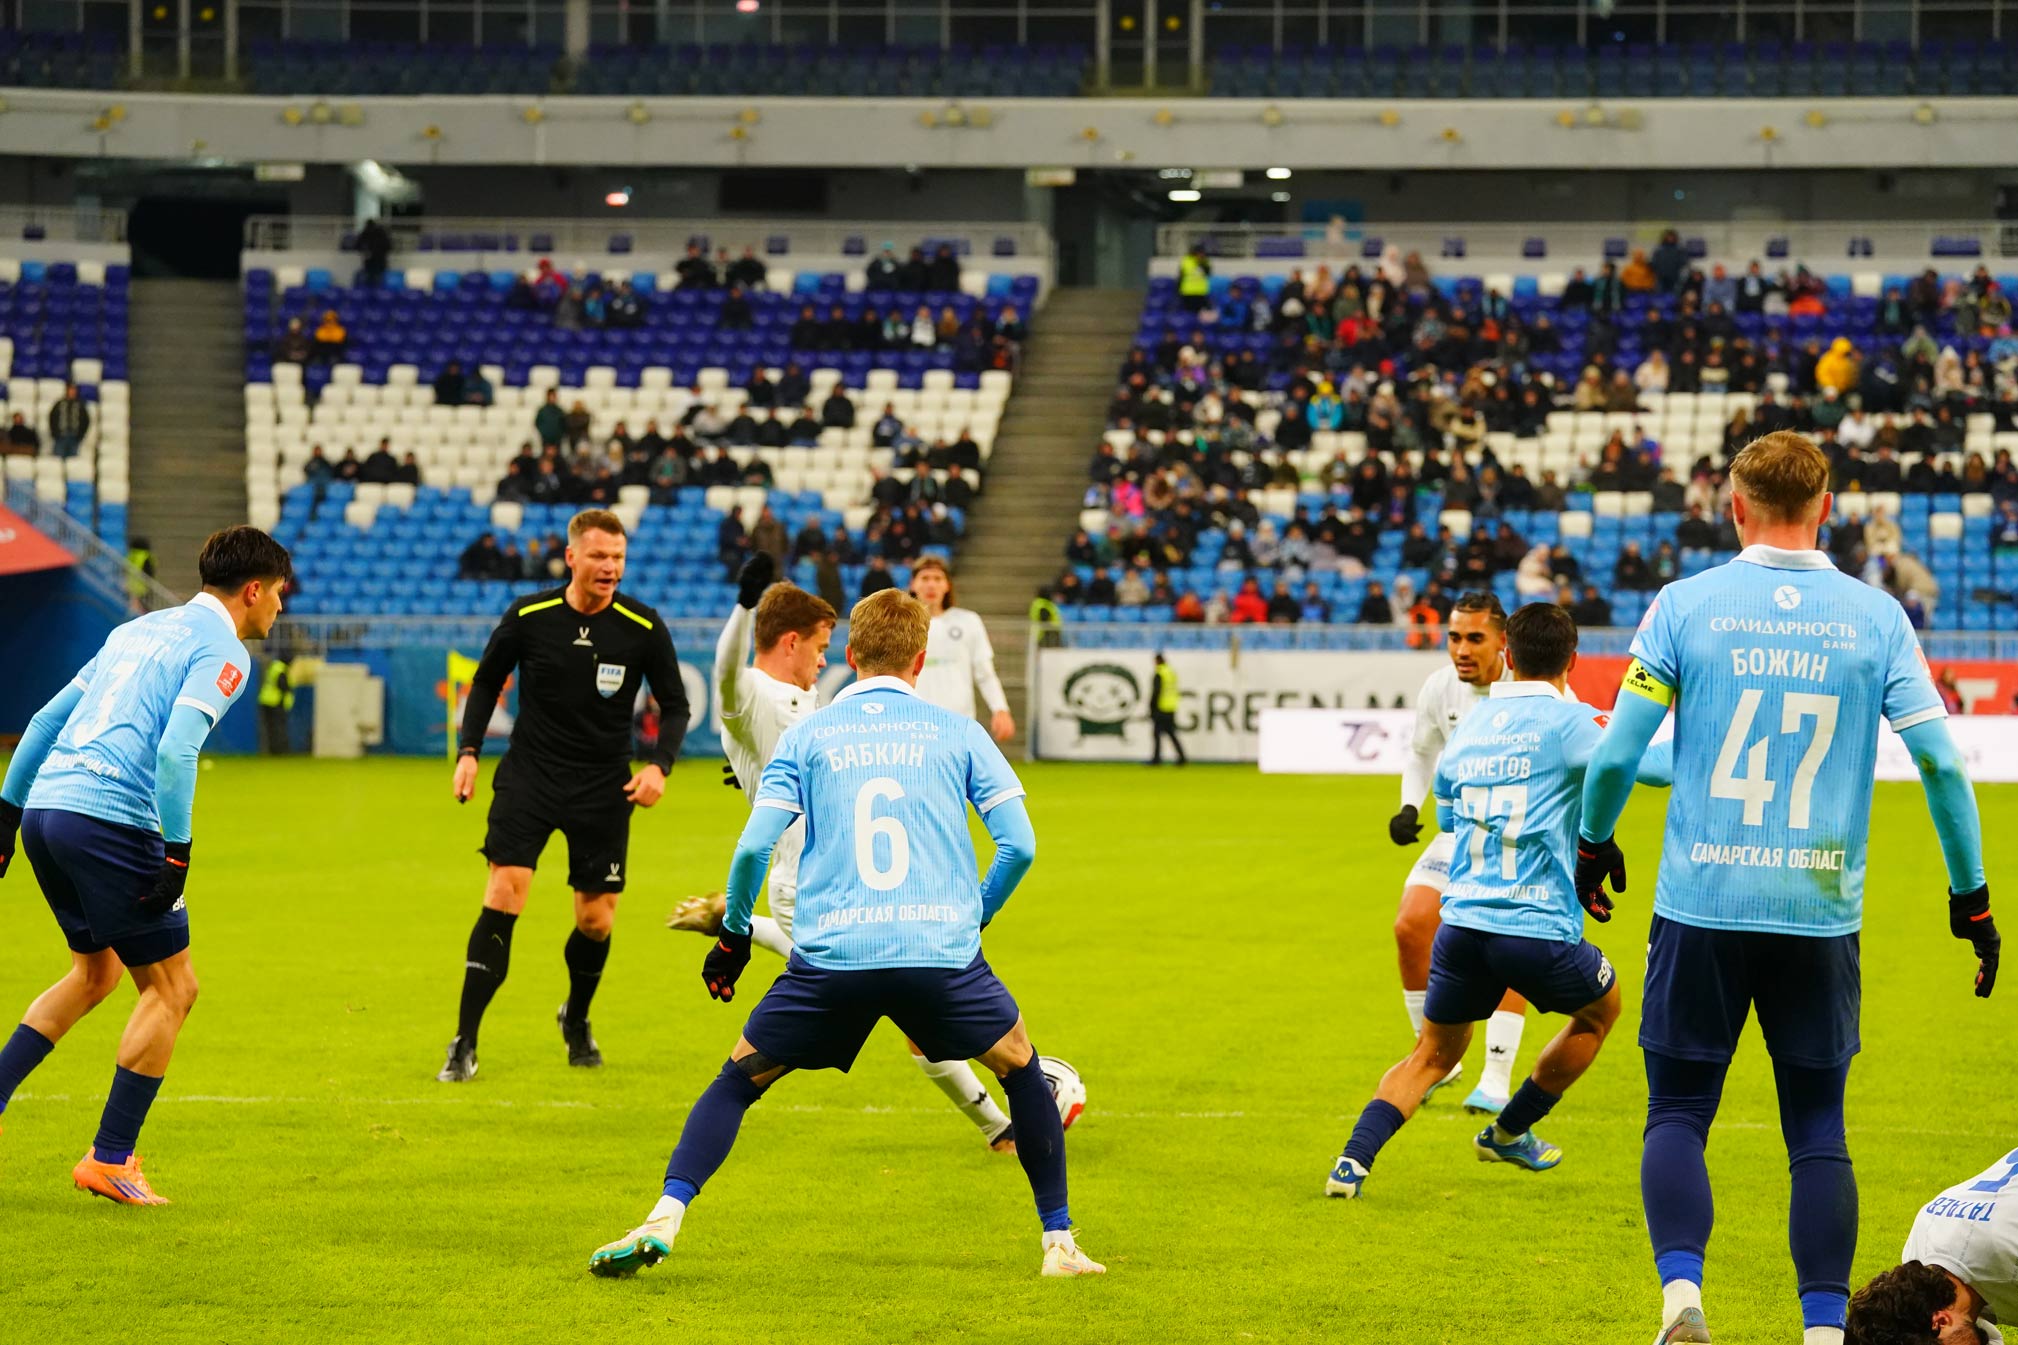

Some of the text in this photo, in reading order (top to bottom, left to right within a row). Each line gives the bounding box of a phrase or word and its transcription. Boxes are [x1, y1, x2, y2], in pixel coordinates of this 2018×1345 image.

[1710, 616, 1857, 639] СОЛИДАРНОСТЬ
[1823, 640, 1856, 651] БАНК
[601, 666, 622, 676] FIFA
[1731, 647, 1829, 683] БОЖИН
[814, 721, 940, 739] СОЛИДАРНОСТЬ
[910, 732, 940, 742] БАНК
[826, 743, 925, 773] БАБКИН
[1457, 755, 1532, 780] АХМЕТОВ
[1710, 688, 1841, 830] 47
[854, 776, 910, 892] 6
[1460, 784, 1528, 881] 77
[1690, 842, 1846, 871] САМАРСКАЯ ОБЛАСТ
[817, 904, 960, 932] САМАРСКАЯ ОБЛАСТЬ
[1926, 1196, 1996, 1222] ТАТАЕВ
